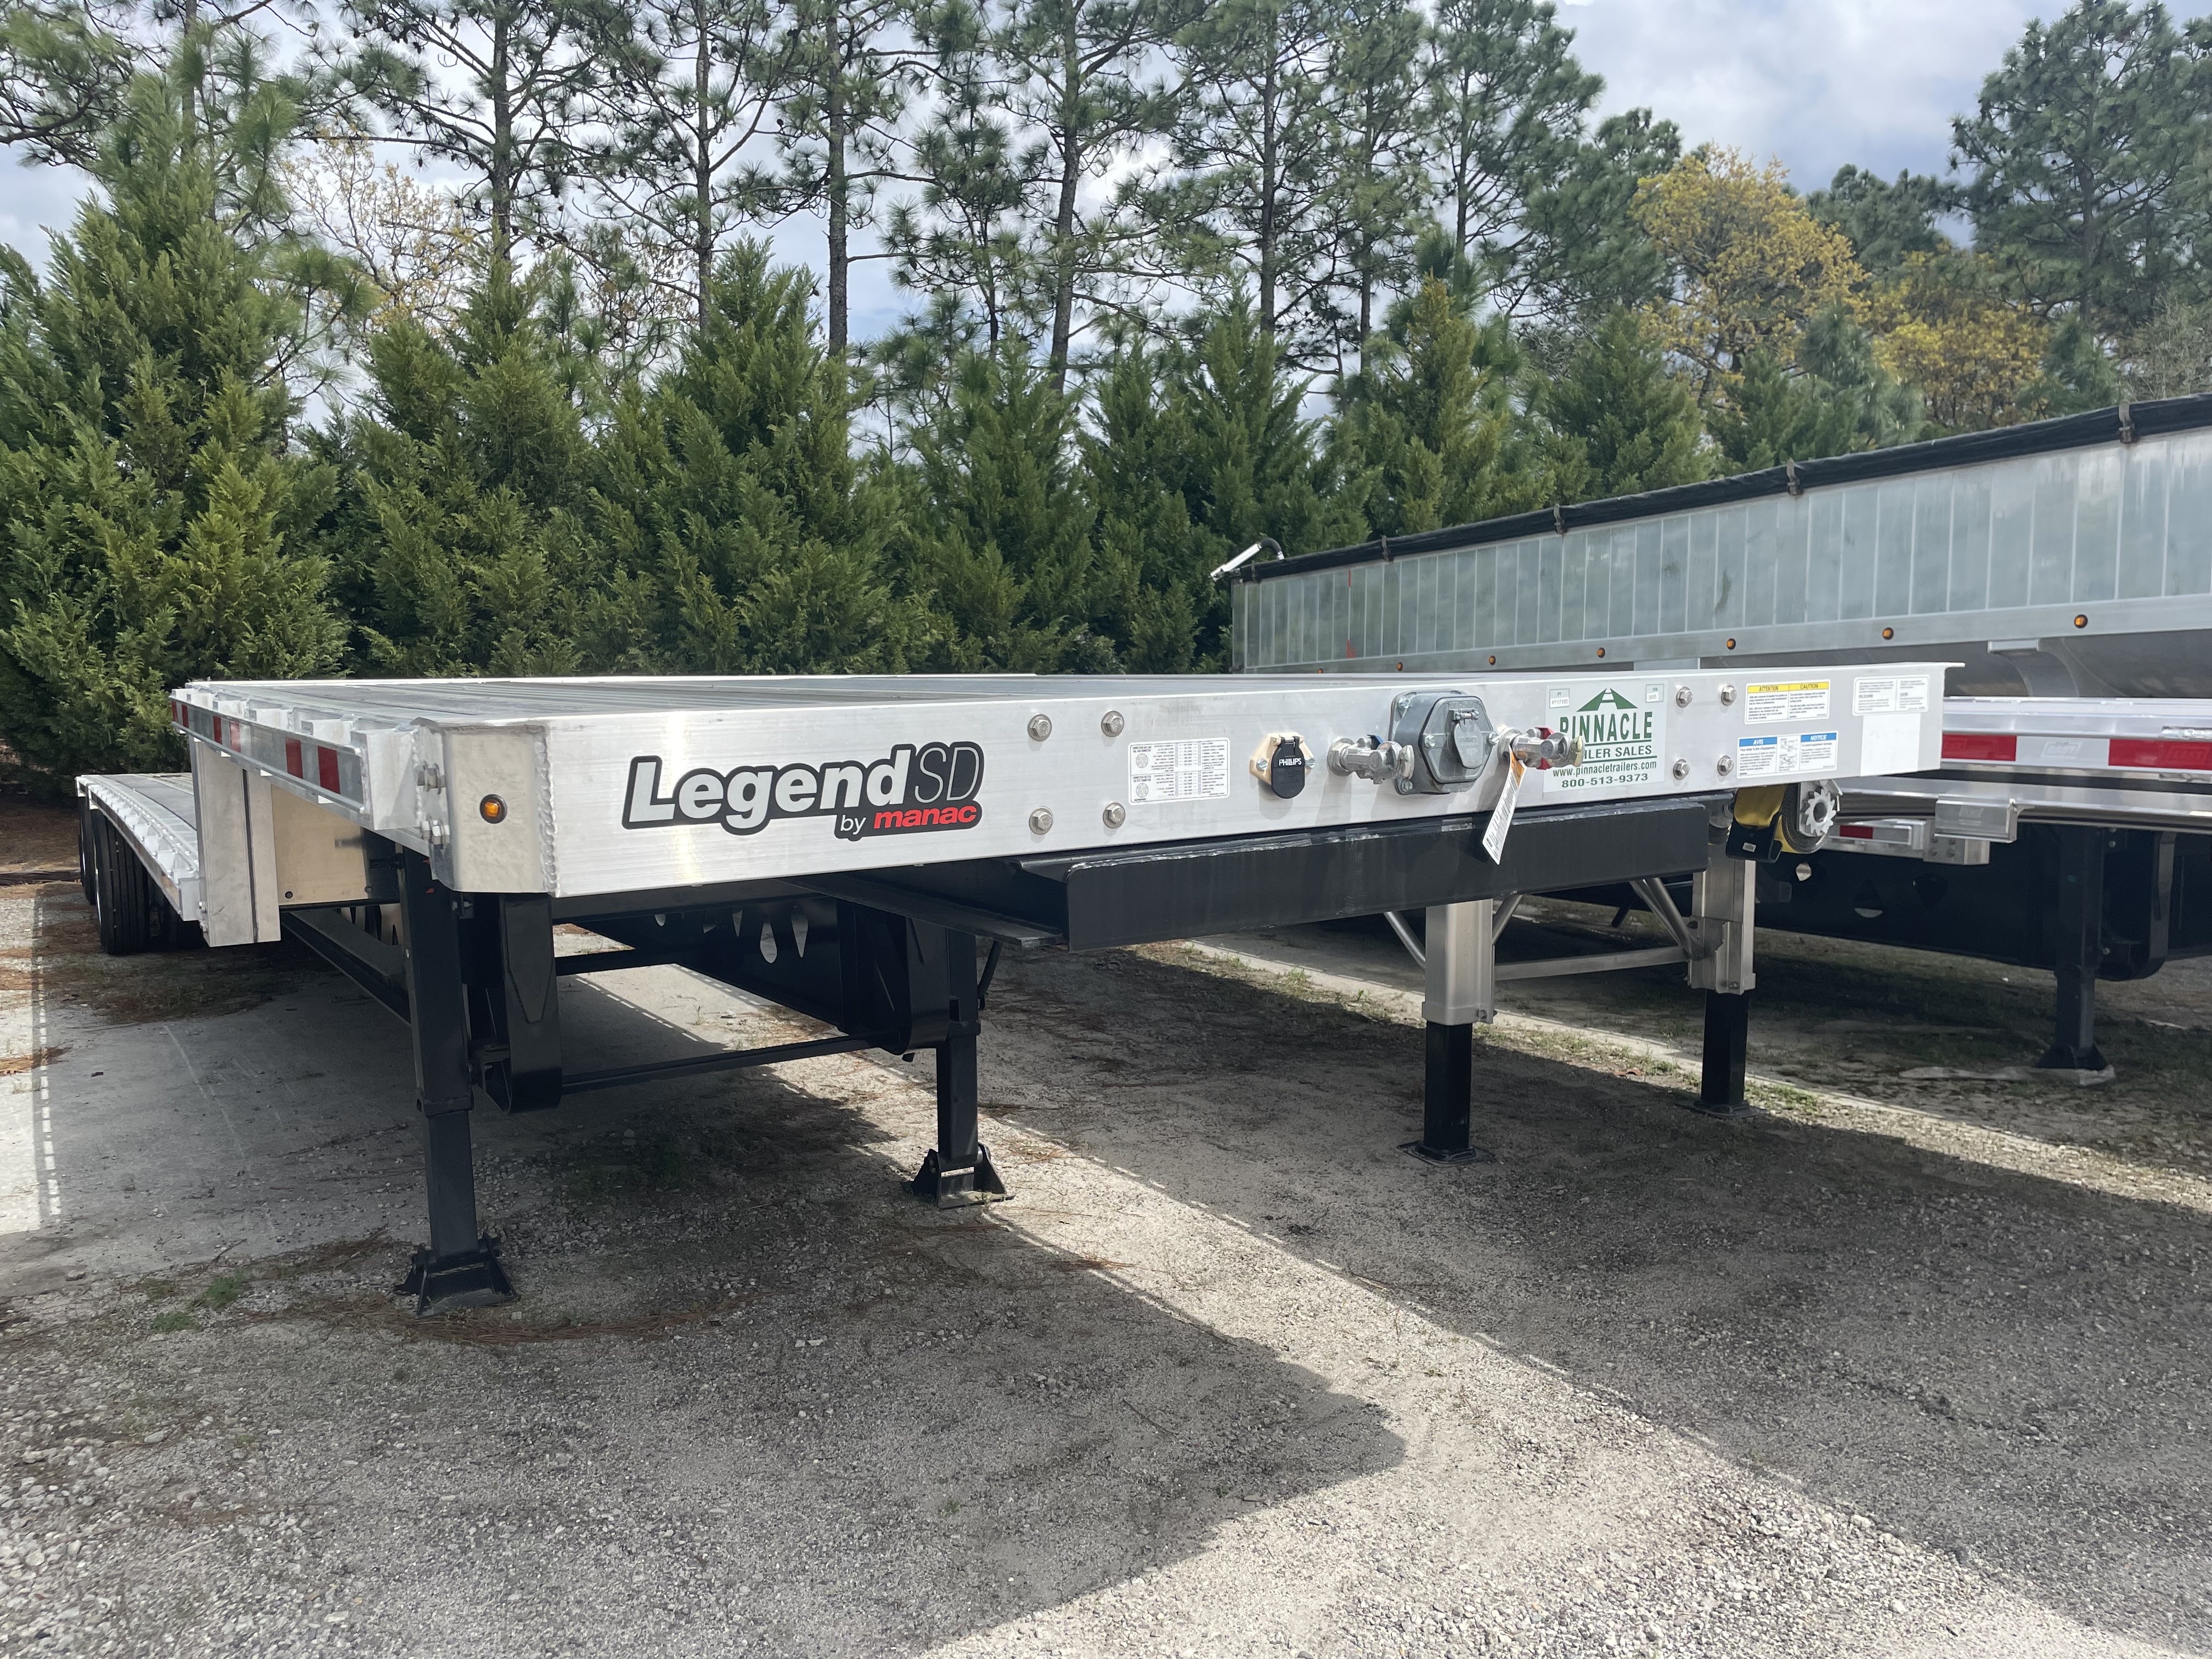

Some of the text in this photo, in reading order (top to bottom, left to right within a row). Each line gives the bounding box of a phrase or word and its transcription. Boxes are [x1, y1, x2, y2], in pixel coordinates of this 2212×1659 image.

[1560, 712, 1653, 743] PINNACLE
[1615, 744, 1652, 758] SALES
[1278, 758, 1302, 766] PHILLIPS
[1553, 760, 1657, 777] www.pinnacletrailers.com
[1561, 772, 1649, 788] 800-513-9373
[840, 805, 978, 835] by manac
